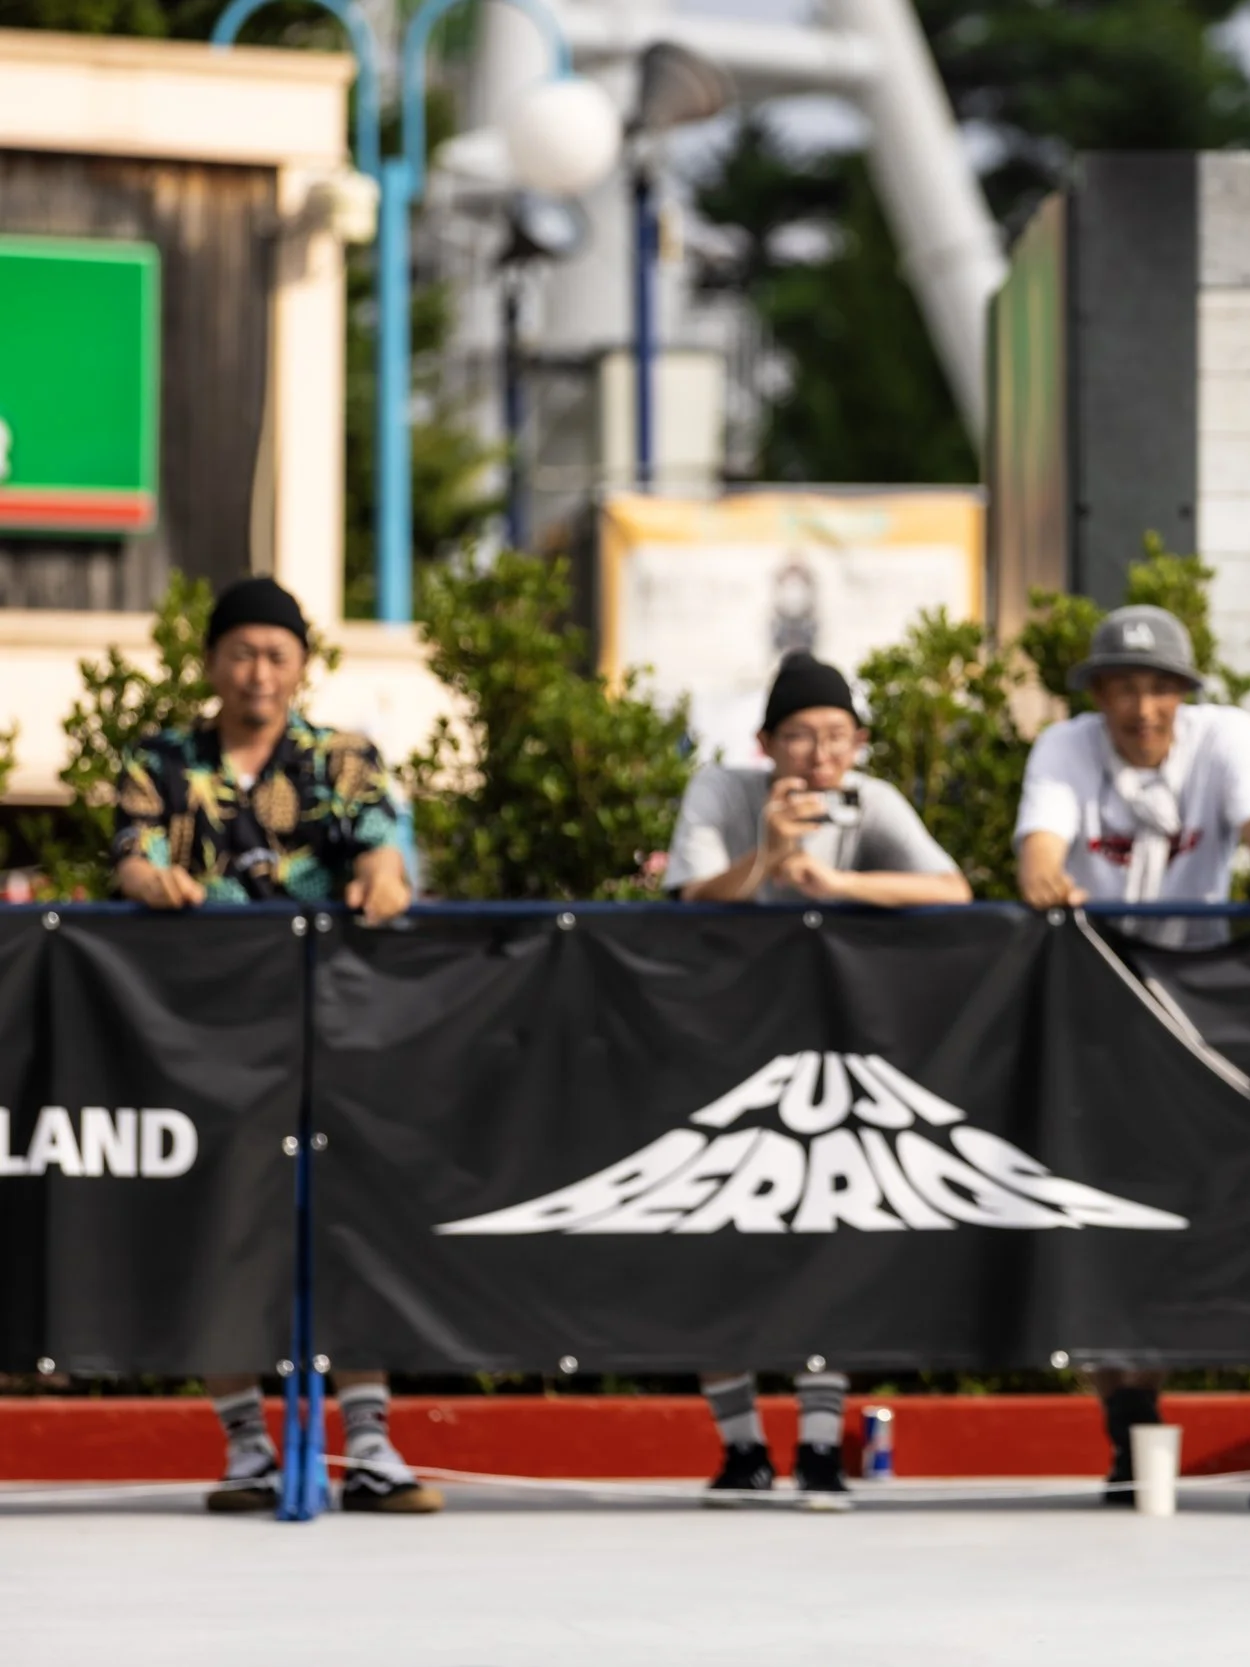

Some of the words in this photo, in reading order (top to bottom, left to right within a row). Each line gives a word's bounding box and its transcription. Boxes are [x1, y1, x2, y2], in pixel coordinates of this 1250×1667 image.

[689, 1049, 967, 1134] FUJI
[0, 1105, 198, 1178] LAND
[431, 1126, 1190, 1236] BERRICS
